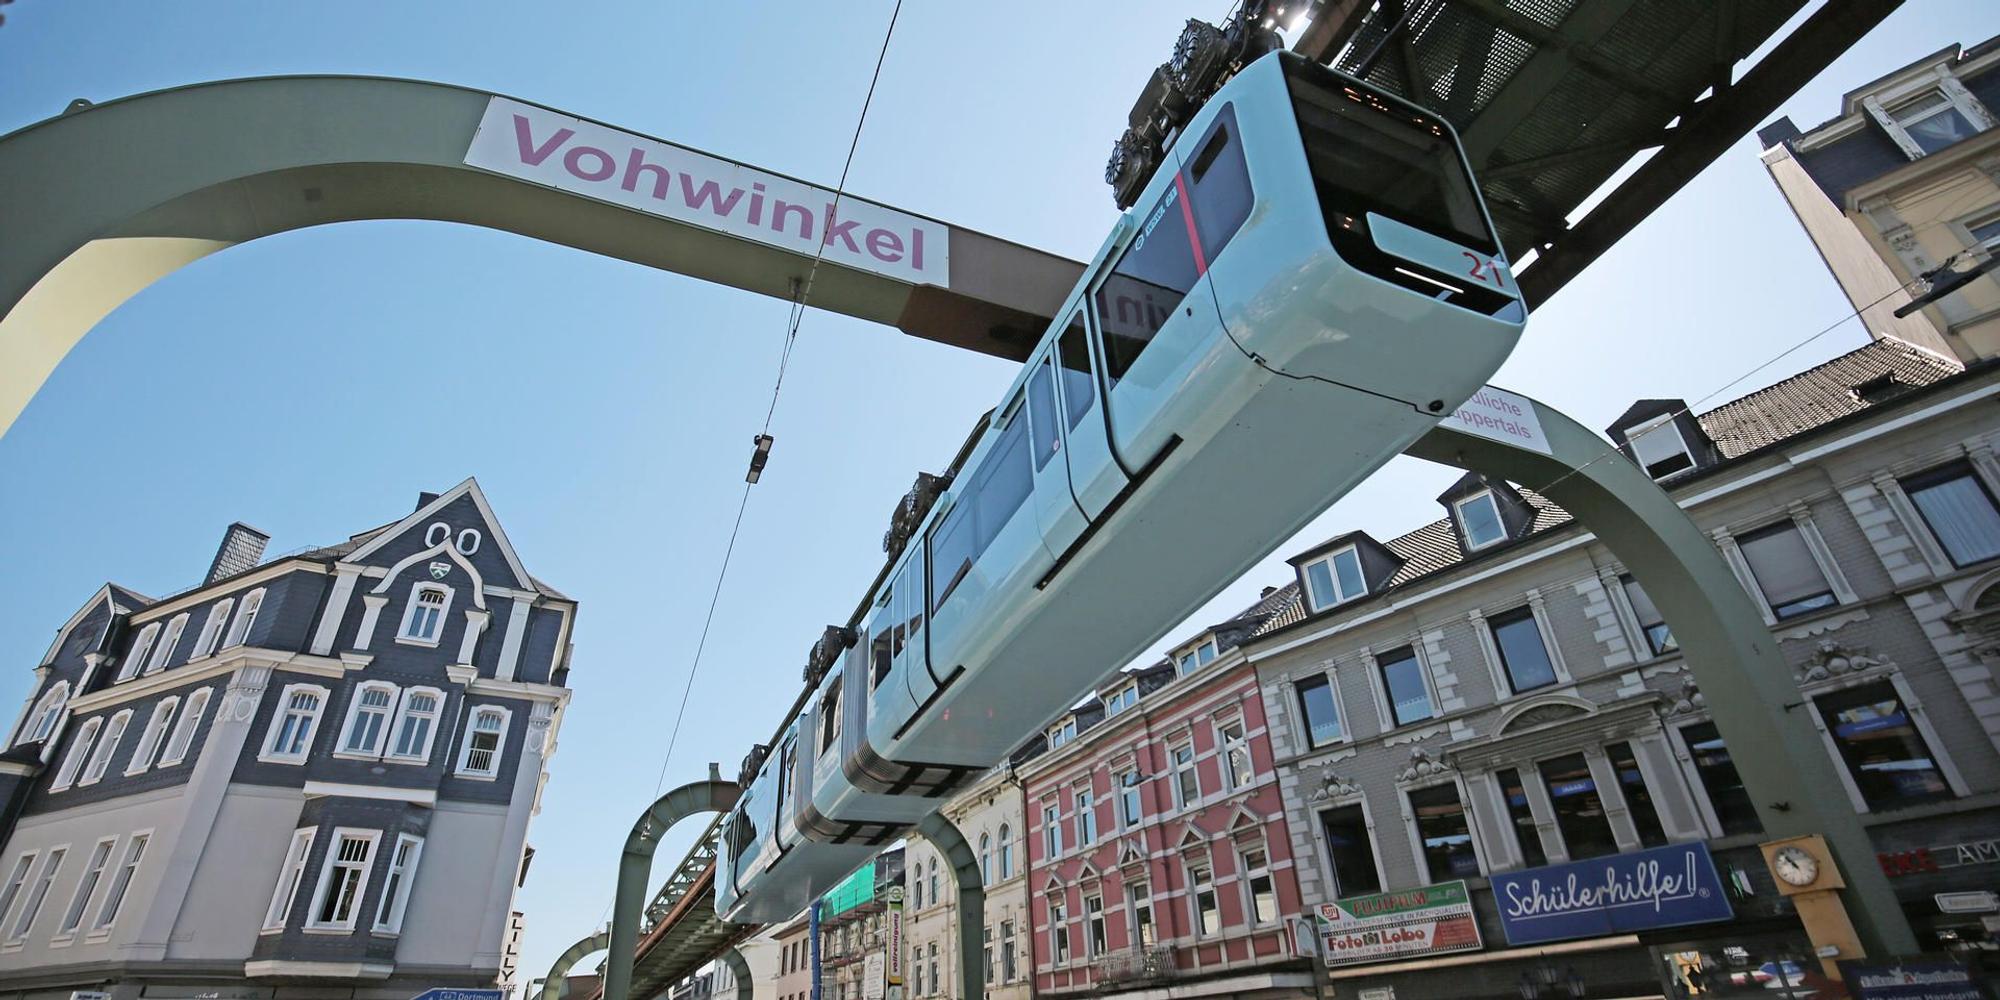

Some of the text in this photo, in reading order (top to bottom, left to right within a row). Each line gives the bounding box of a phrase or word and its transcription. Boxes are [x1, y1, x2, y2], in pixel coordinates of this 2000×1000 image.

[512, 113, 924, 271] Vohwinkel
[1462, 251, 1504, 287] 21
[502, 918, 522, 982] LILLY
[1328, 935, 1363, 951] Foto
[1381, 927, 1426, 945] Lobo
